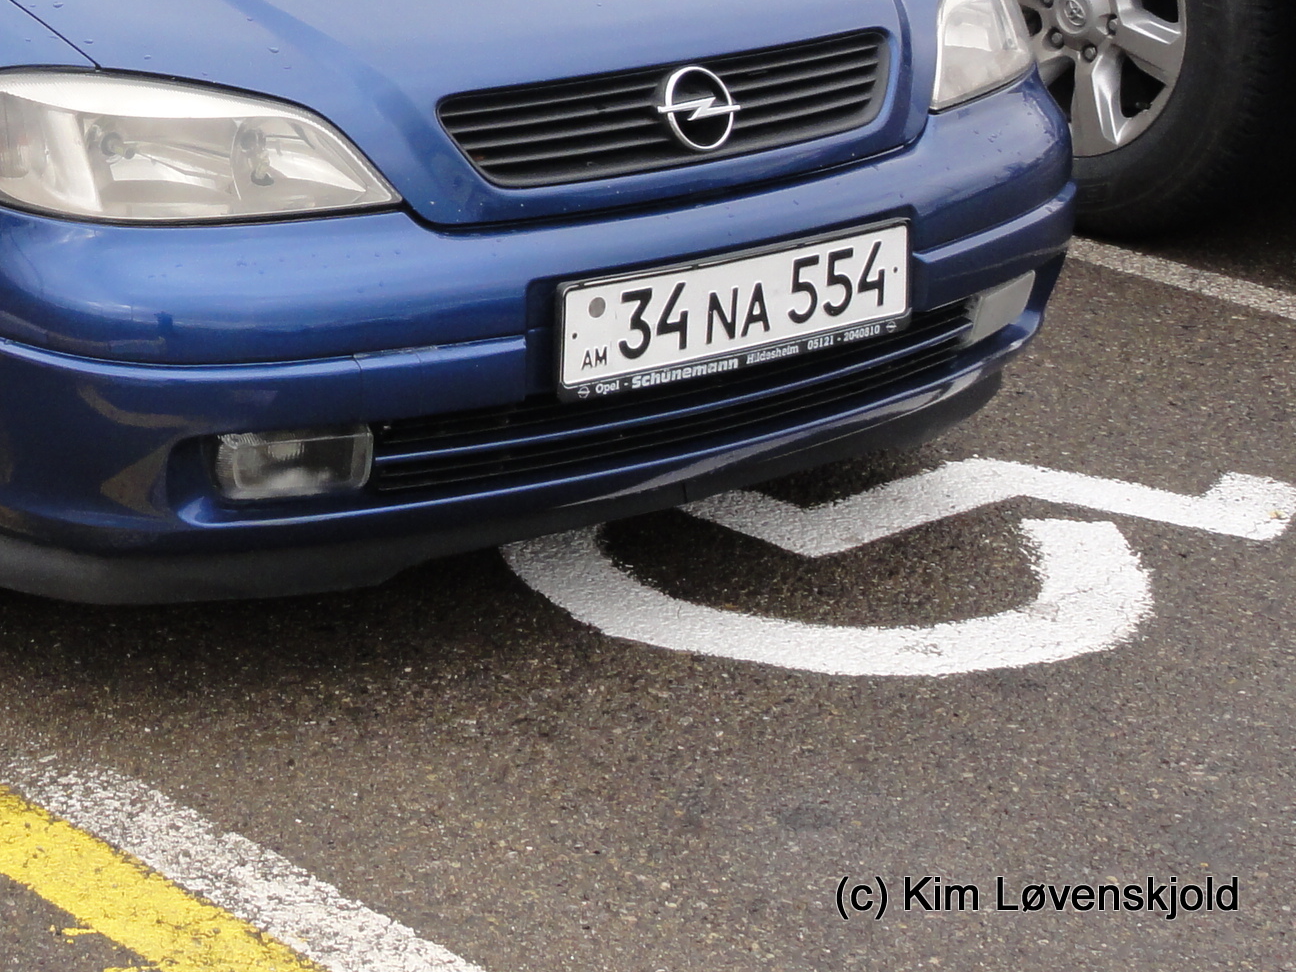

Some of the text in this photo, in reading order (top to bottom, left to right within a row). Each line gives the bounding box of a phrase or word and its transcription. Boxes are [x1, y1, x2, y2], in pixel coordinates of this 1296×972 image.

[617, 240, 885, 360] 34 NA 554
[580, 345, 608, 371] AM
[595, 379, 620, 395] Opel
[631, 357, 739, 389] Schünemann
[746, 344, 800, 365] Hildesheim
[807, 335, 835, 351] 05121
